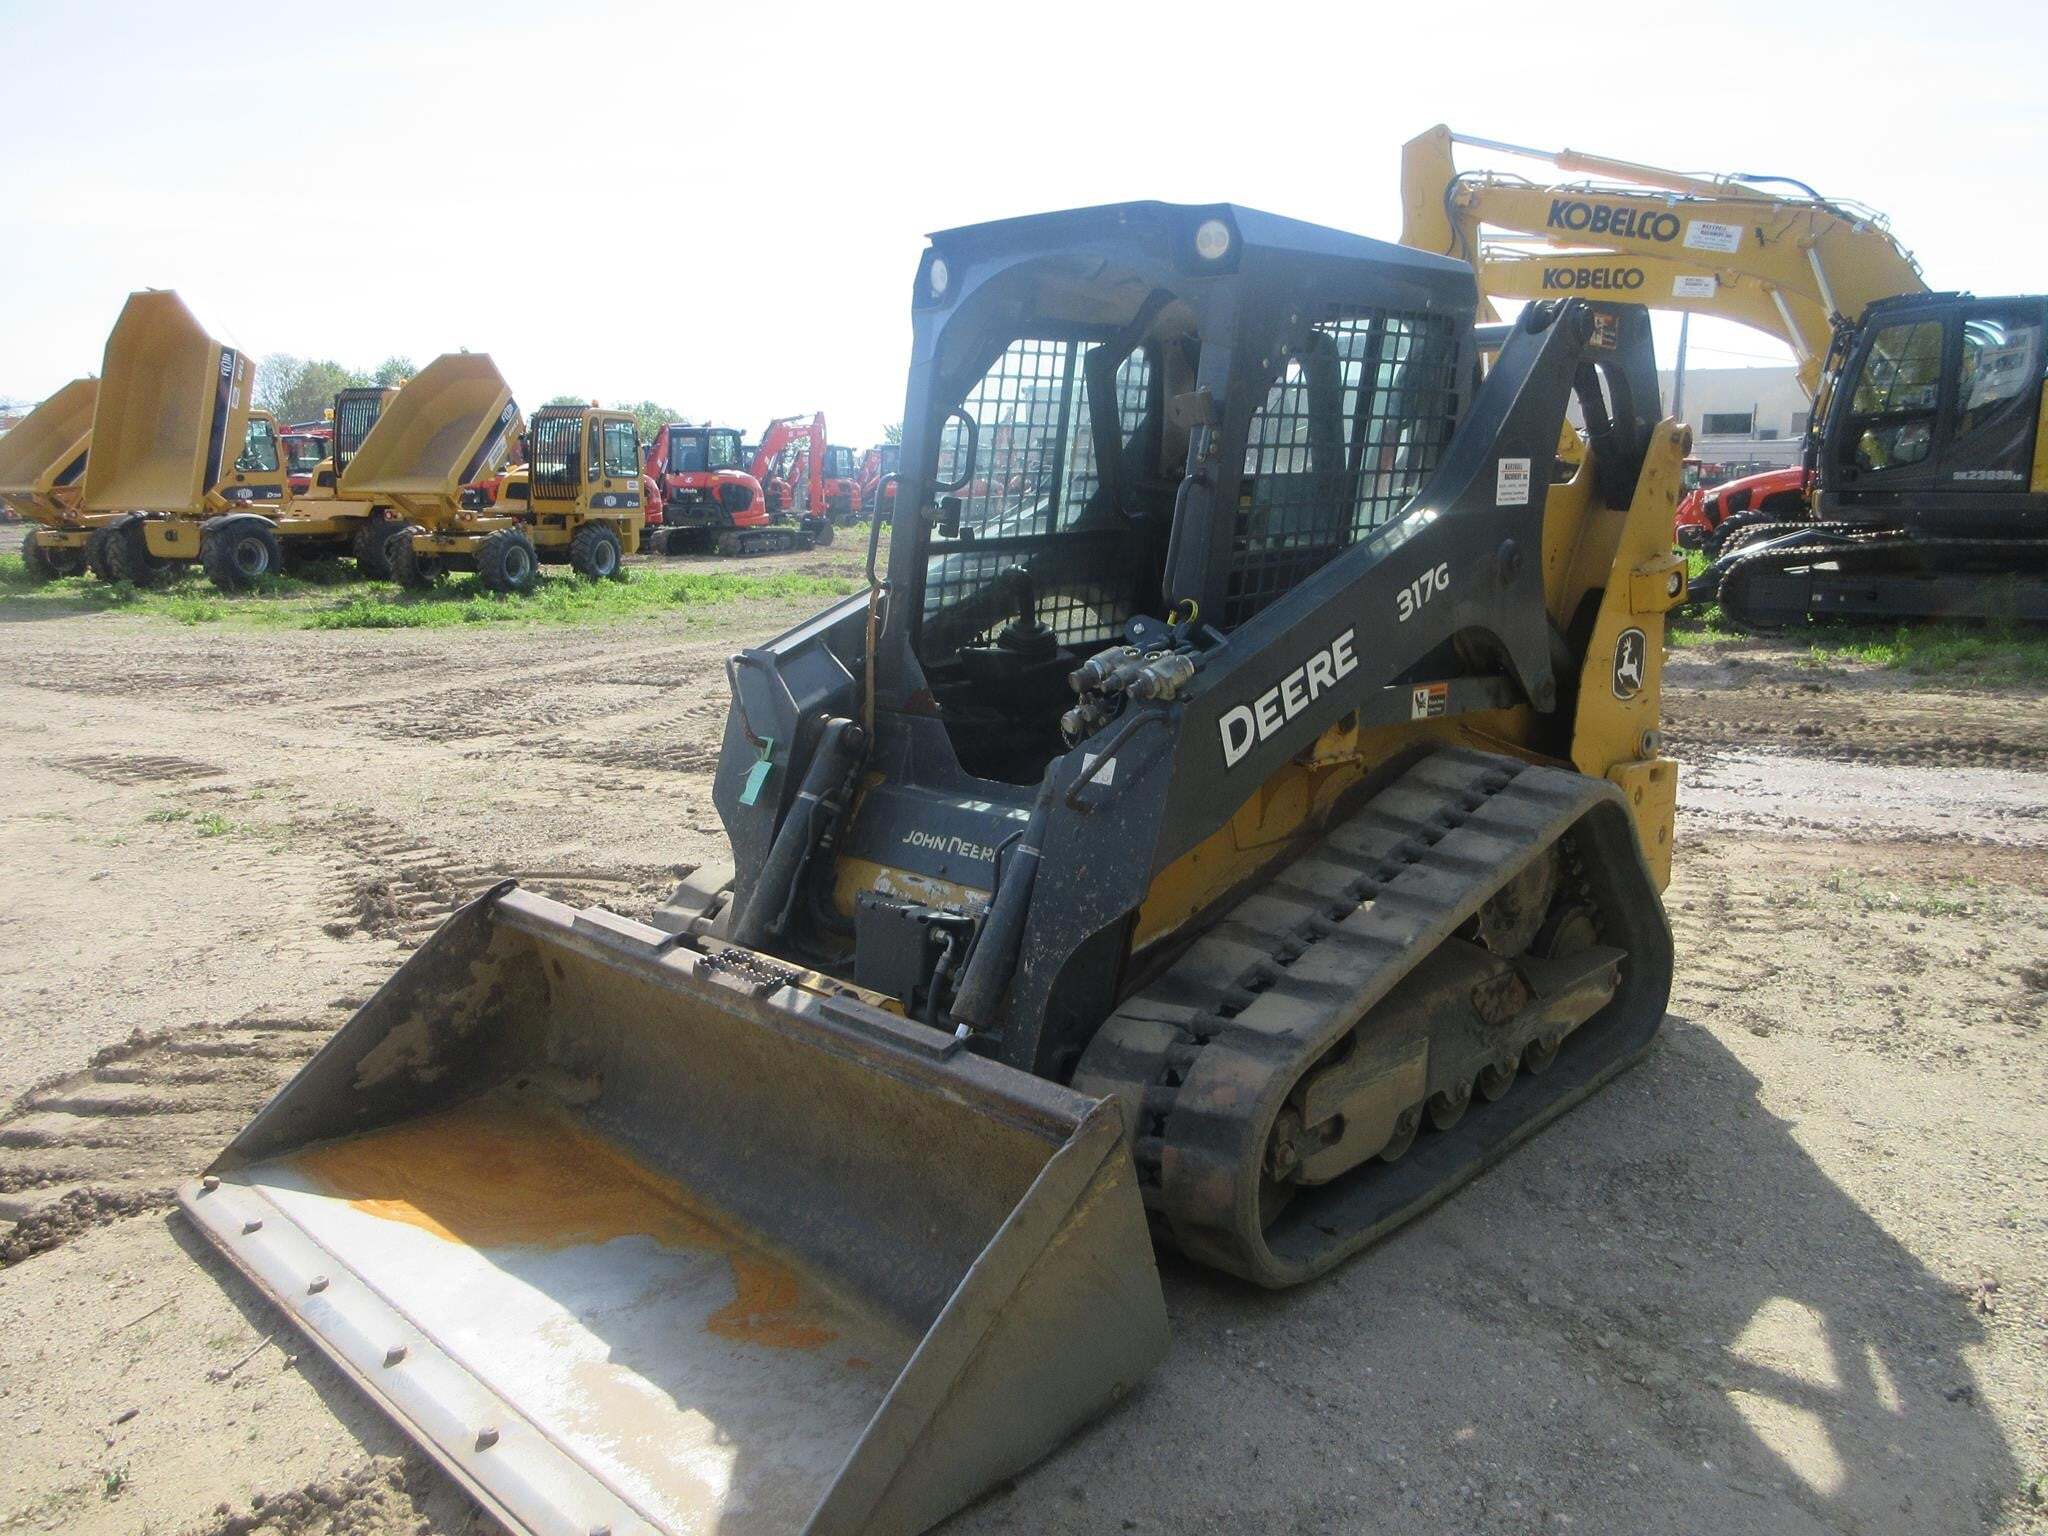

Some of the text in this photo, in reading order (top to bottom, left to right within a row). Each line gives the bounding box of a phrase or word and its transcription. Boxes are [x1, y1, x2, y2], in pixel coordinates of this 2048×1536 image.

[1547, 199, 1680, 242] KOBELCO
[1542, 267, 1644, 290] KOBELCO
[1396, 562, 1450, 622] 317G
[1219, 628, 1358, 768] DEERE
[902, 830, 946, 851] JOHN
